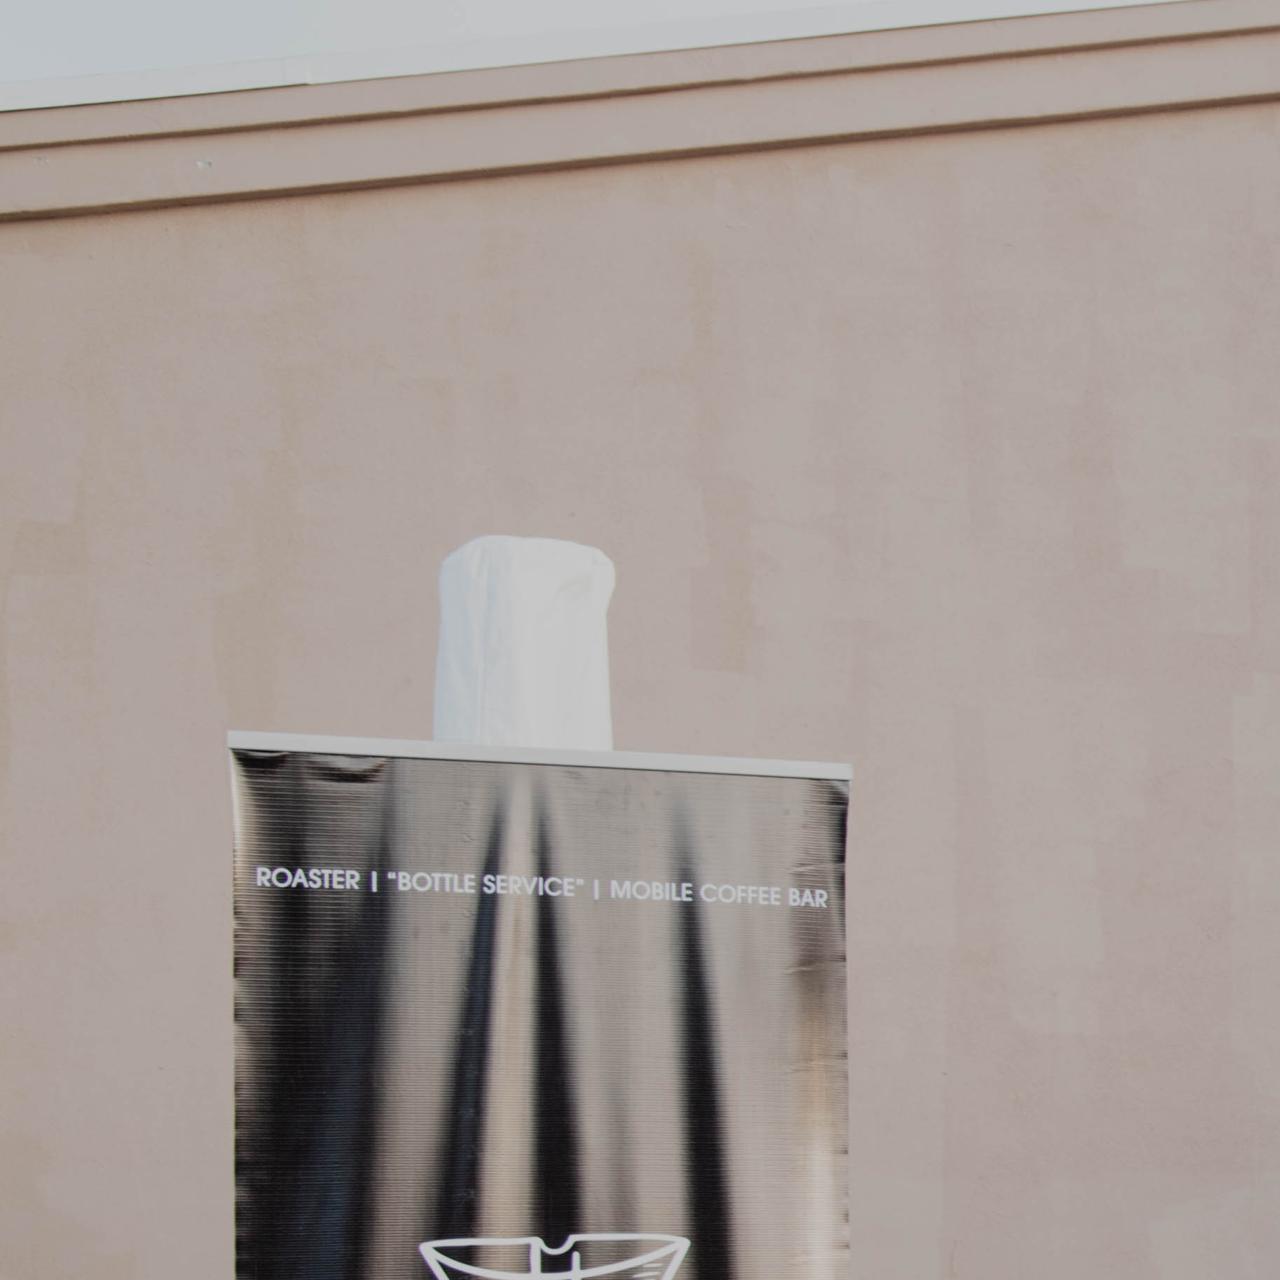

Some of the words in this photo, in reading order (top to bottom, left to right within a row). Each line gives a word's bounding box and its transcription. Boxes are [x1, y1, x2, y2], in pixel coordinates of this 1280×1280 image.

[256, 866, 360, 891] ROASTER
[610, 879, 694, 903] MOBILE
[700, 883, 782, 906] COFFEE
[789, 888, 829, 909] BAR
